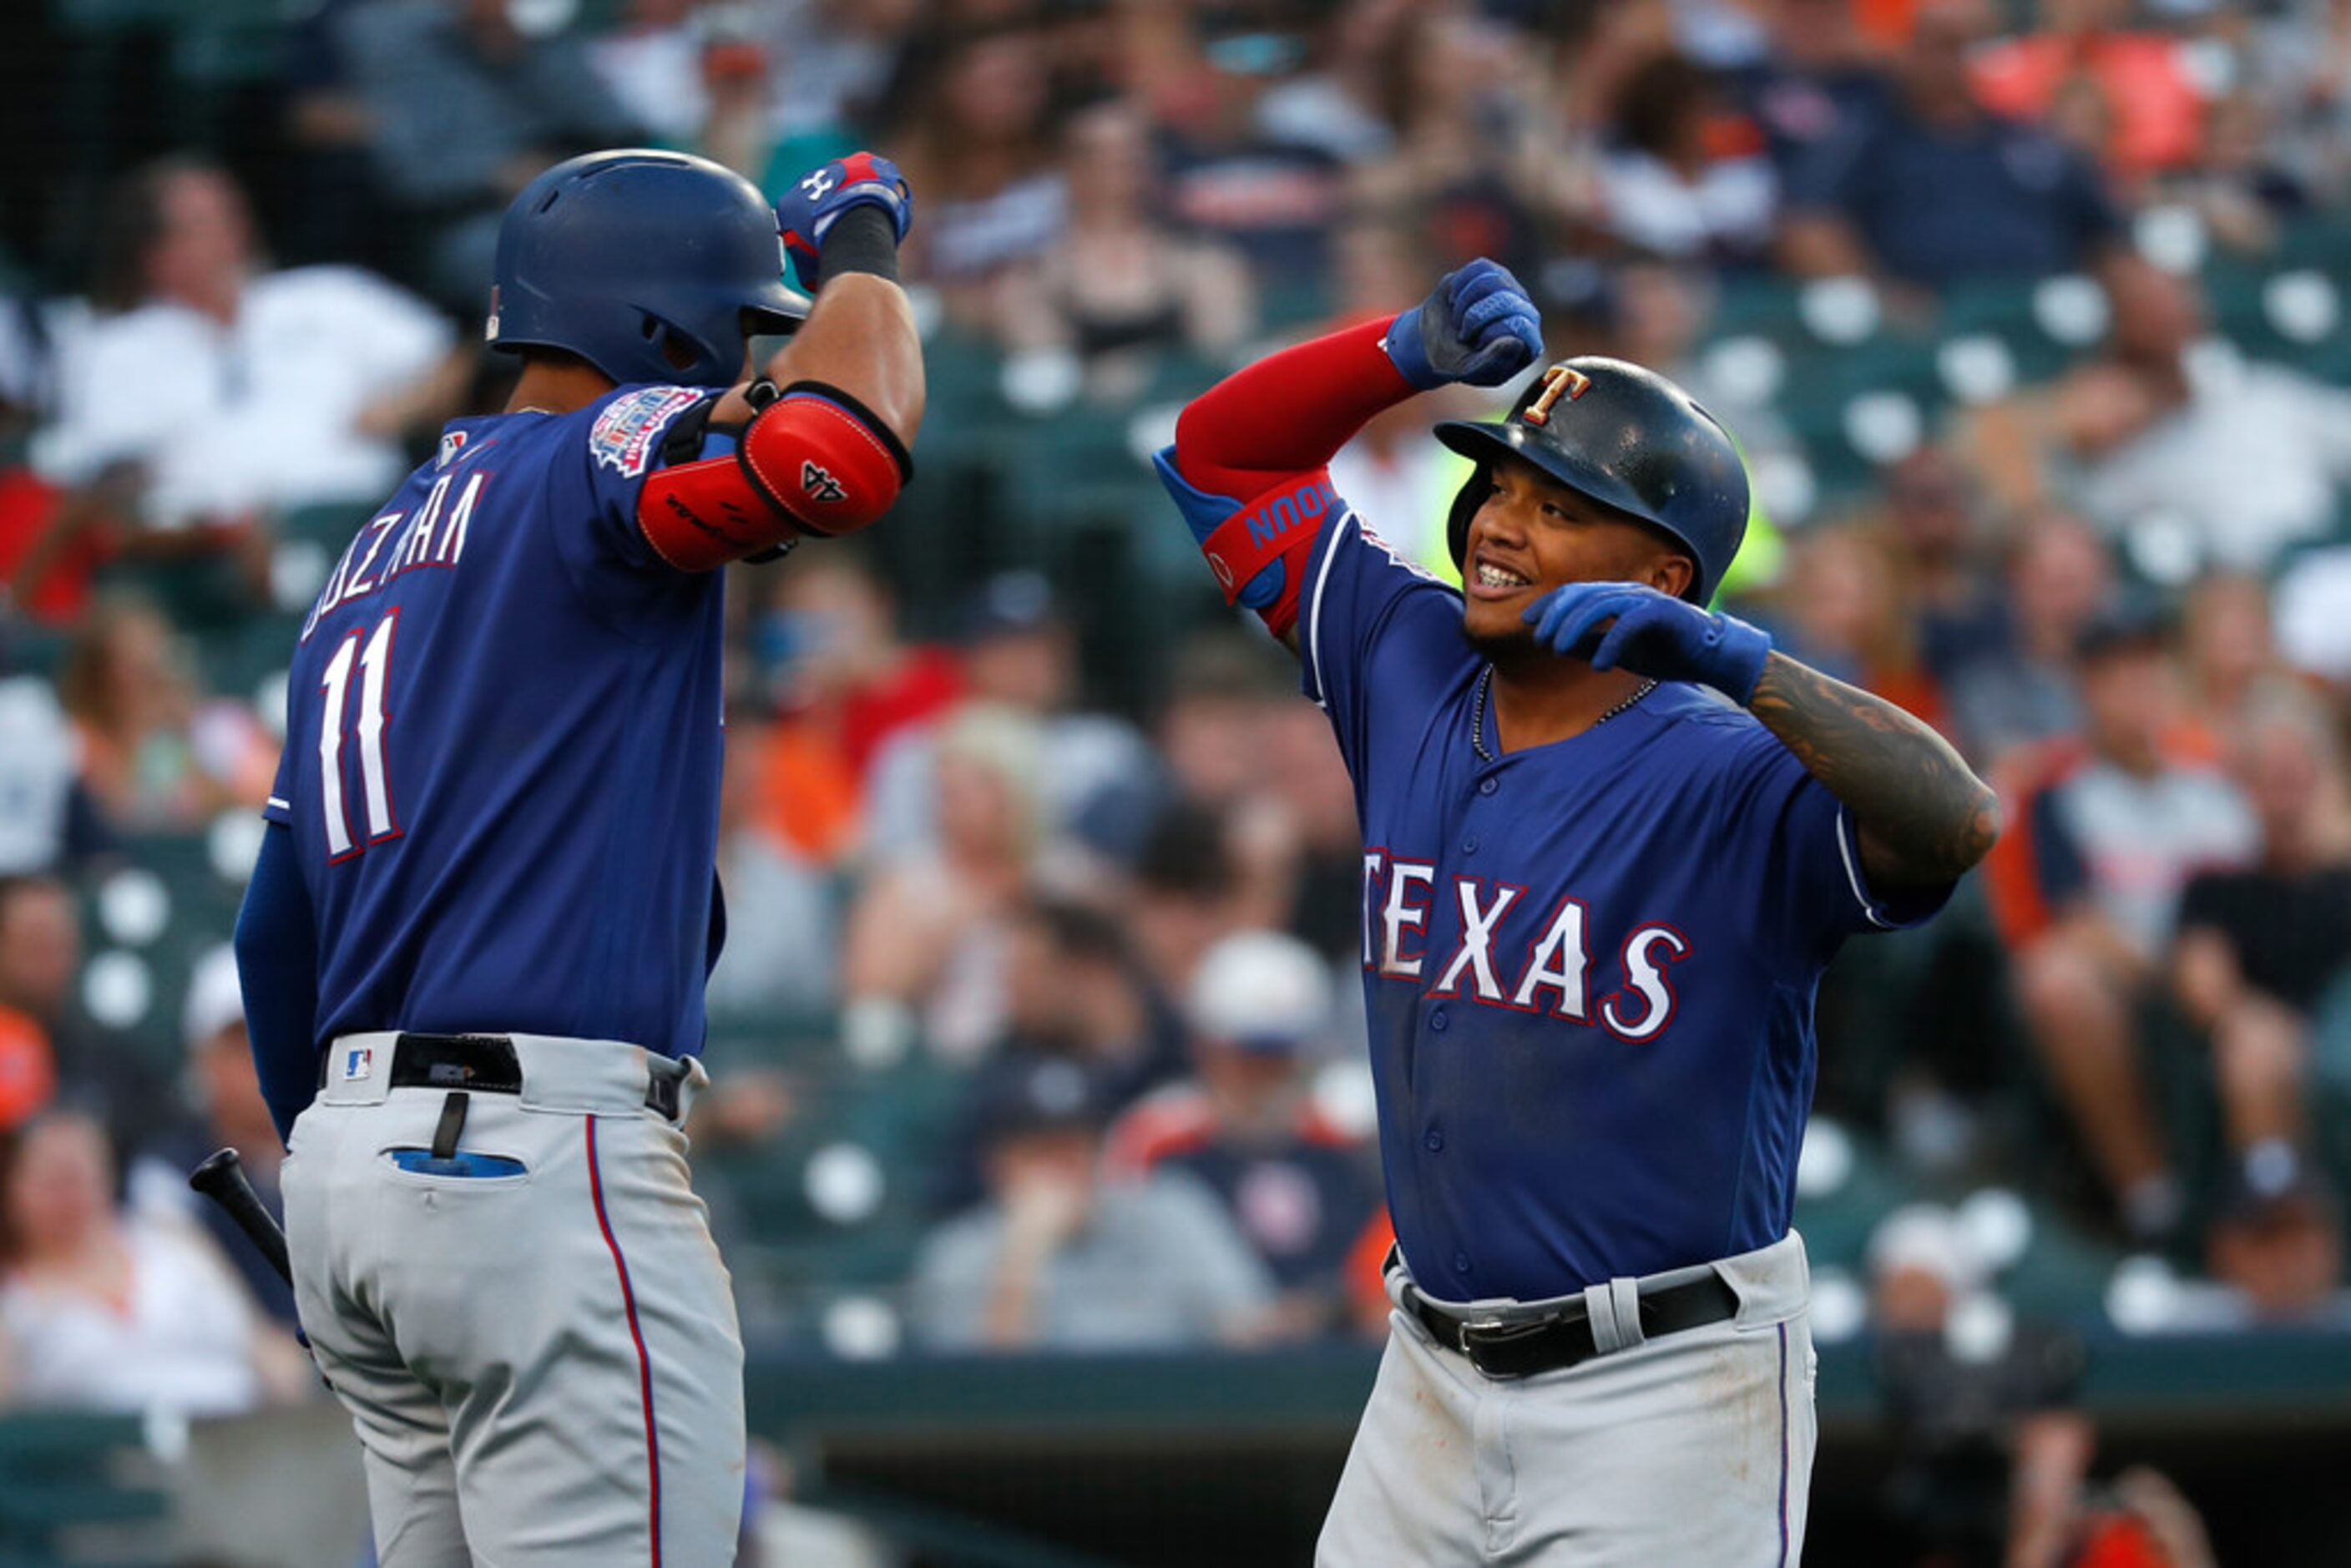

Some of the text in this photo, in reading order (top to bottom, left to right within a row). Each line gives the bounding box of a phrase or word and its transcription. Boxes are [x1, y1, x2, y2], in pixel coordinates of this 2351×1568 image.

[1522, 365, 1591, 426] T
[320, 605, 405, 867] 11
[1363, 846, 1693, 1044] TEXAS
